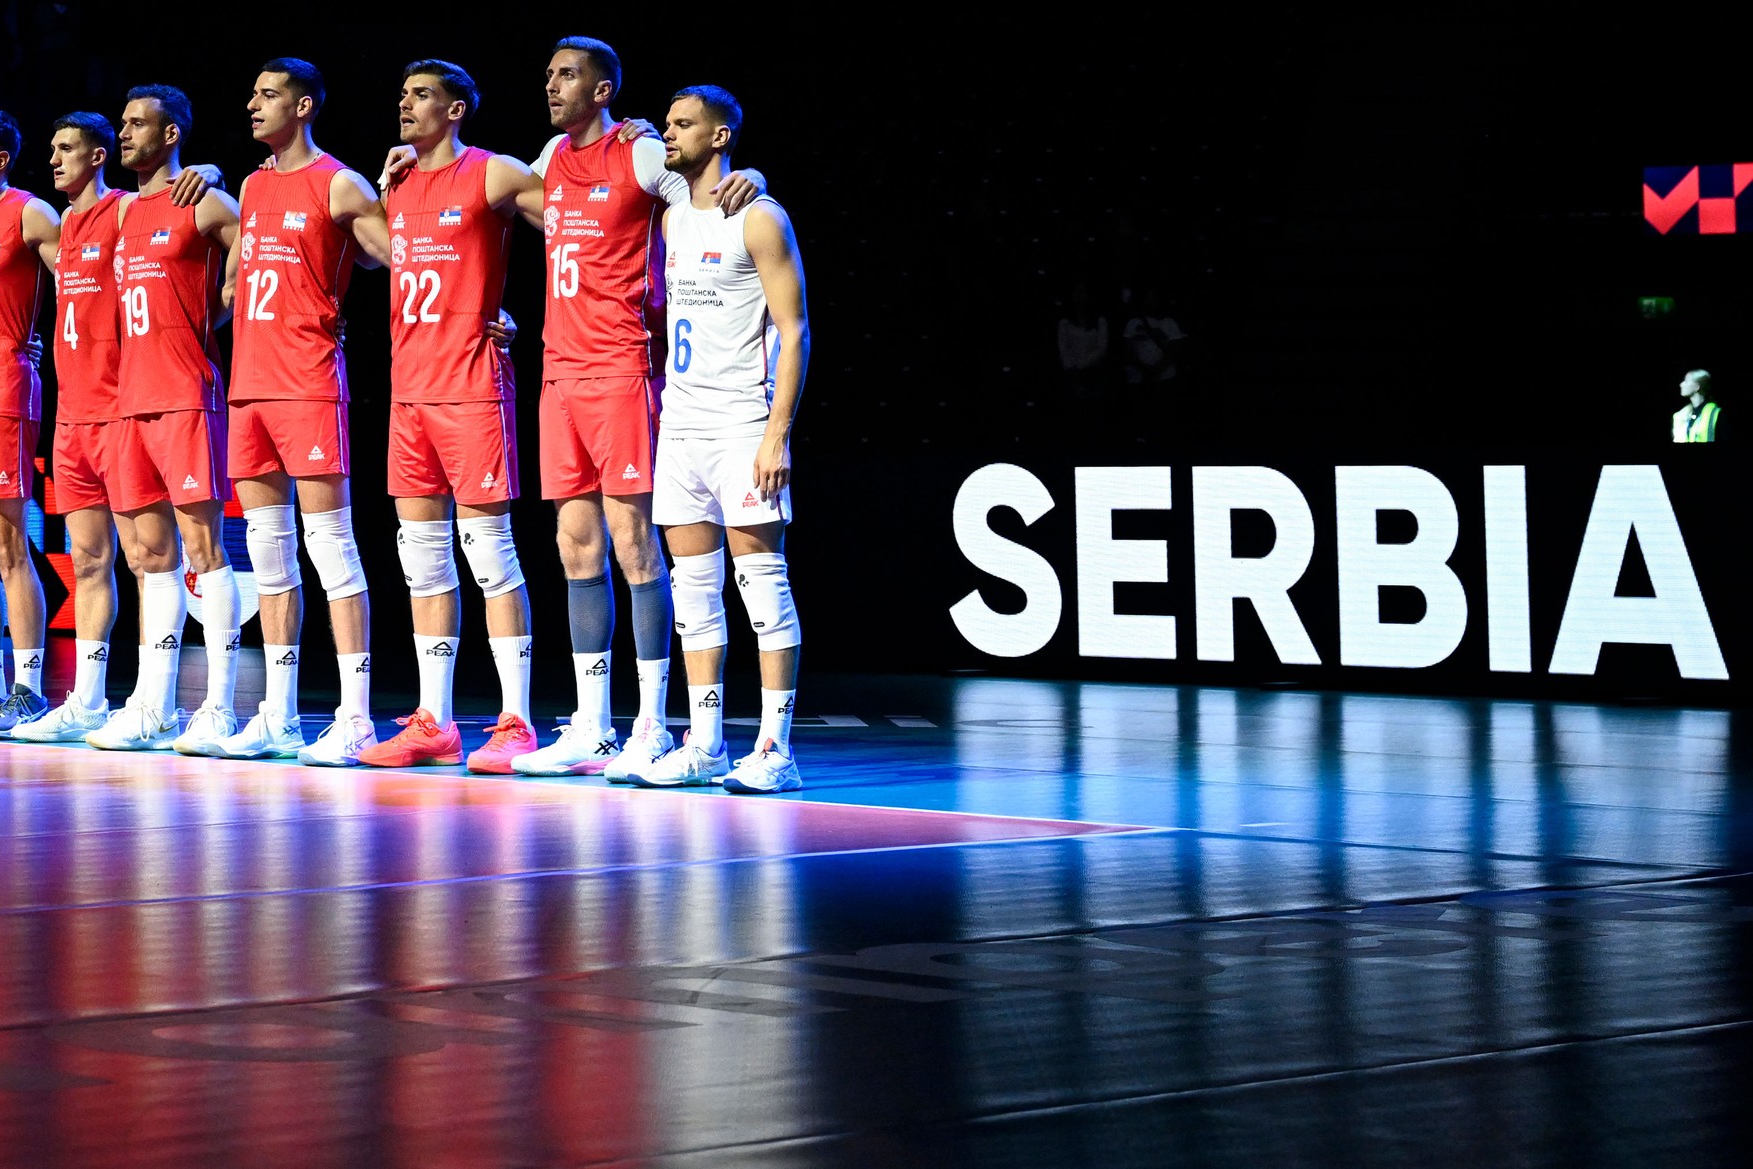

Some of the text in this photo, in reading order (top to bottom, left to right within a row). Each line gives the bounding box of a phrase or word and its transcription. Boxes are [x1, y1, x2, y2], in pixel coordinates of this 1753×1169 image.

[563, 219, 599, 227] ПОШТАНСКА
[412, 244, 454, 253] ПОШТАНСКА
[411, 254, 460, 262] ШТЕДИОНИЦА
[550, 243, 580, 299] 15
[247, 269, 279, 321] 12
[399, 269, 441, 324] 22
[677, 288, 717, 297] ПОШТАНСКА
[676, 298, 724, 307] ШТЕДИОНИЦА
[121, 286, 150, 338] 19
[64, 301, 79, 350] 4
[673, 318, 692, 374] 6
[622, 472, 640, 480] PEAK
[742, 500, 759, 508] PEAK
[949, 462, 1730, 680] SERBIA
[426, 649, 455, 657] PEAK
